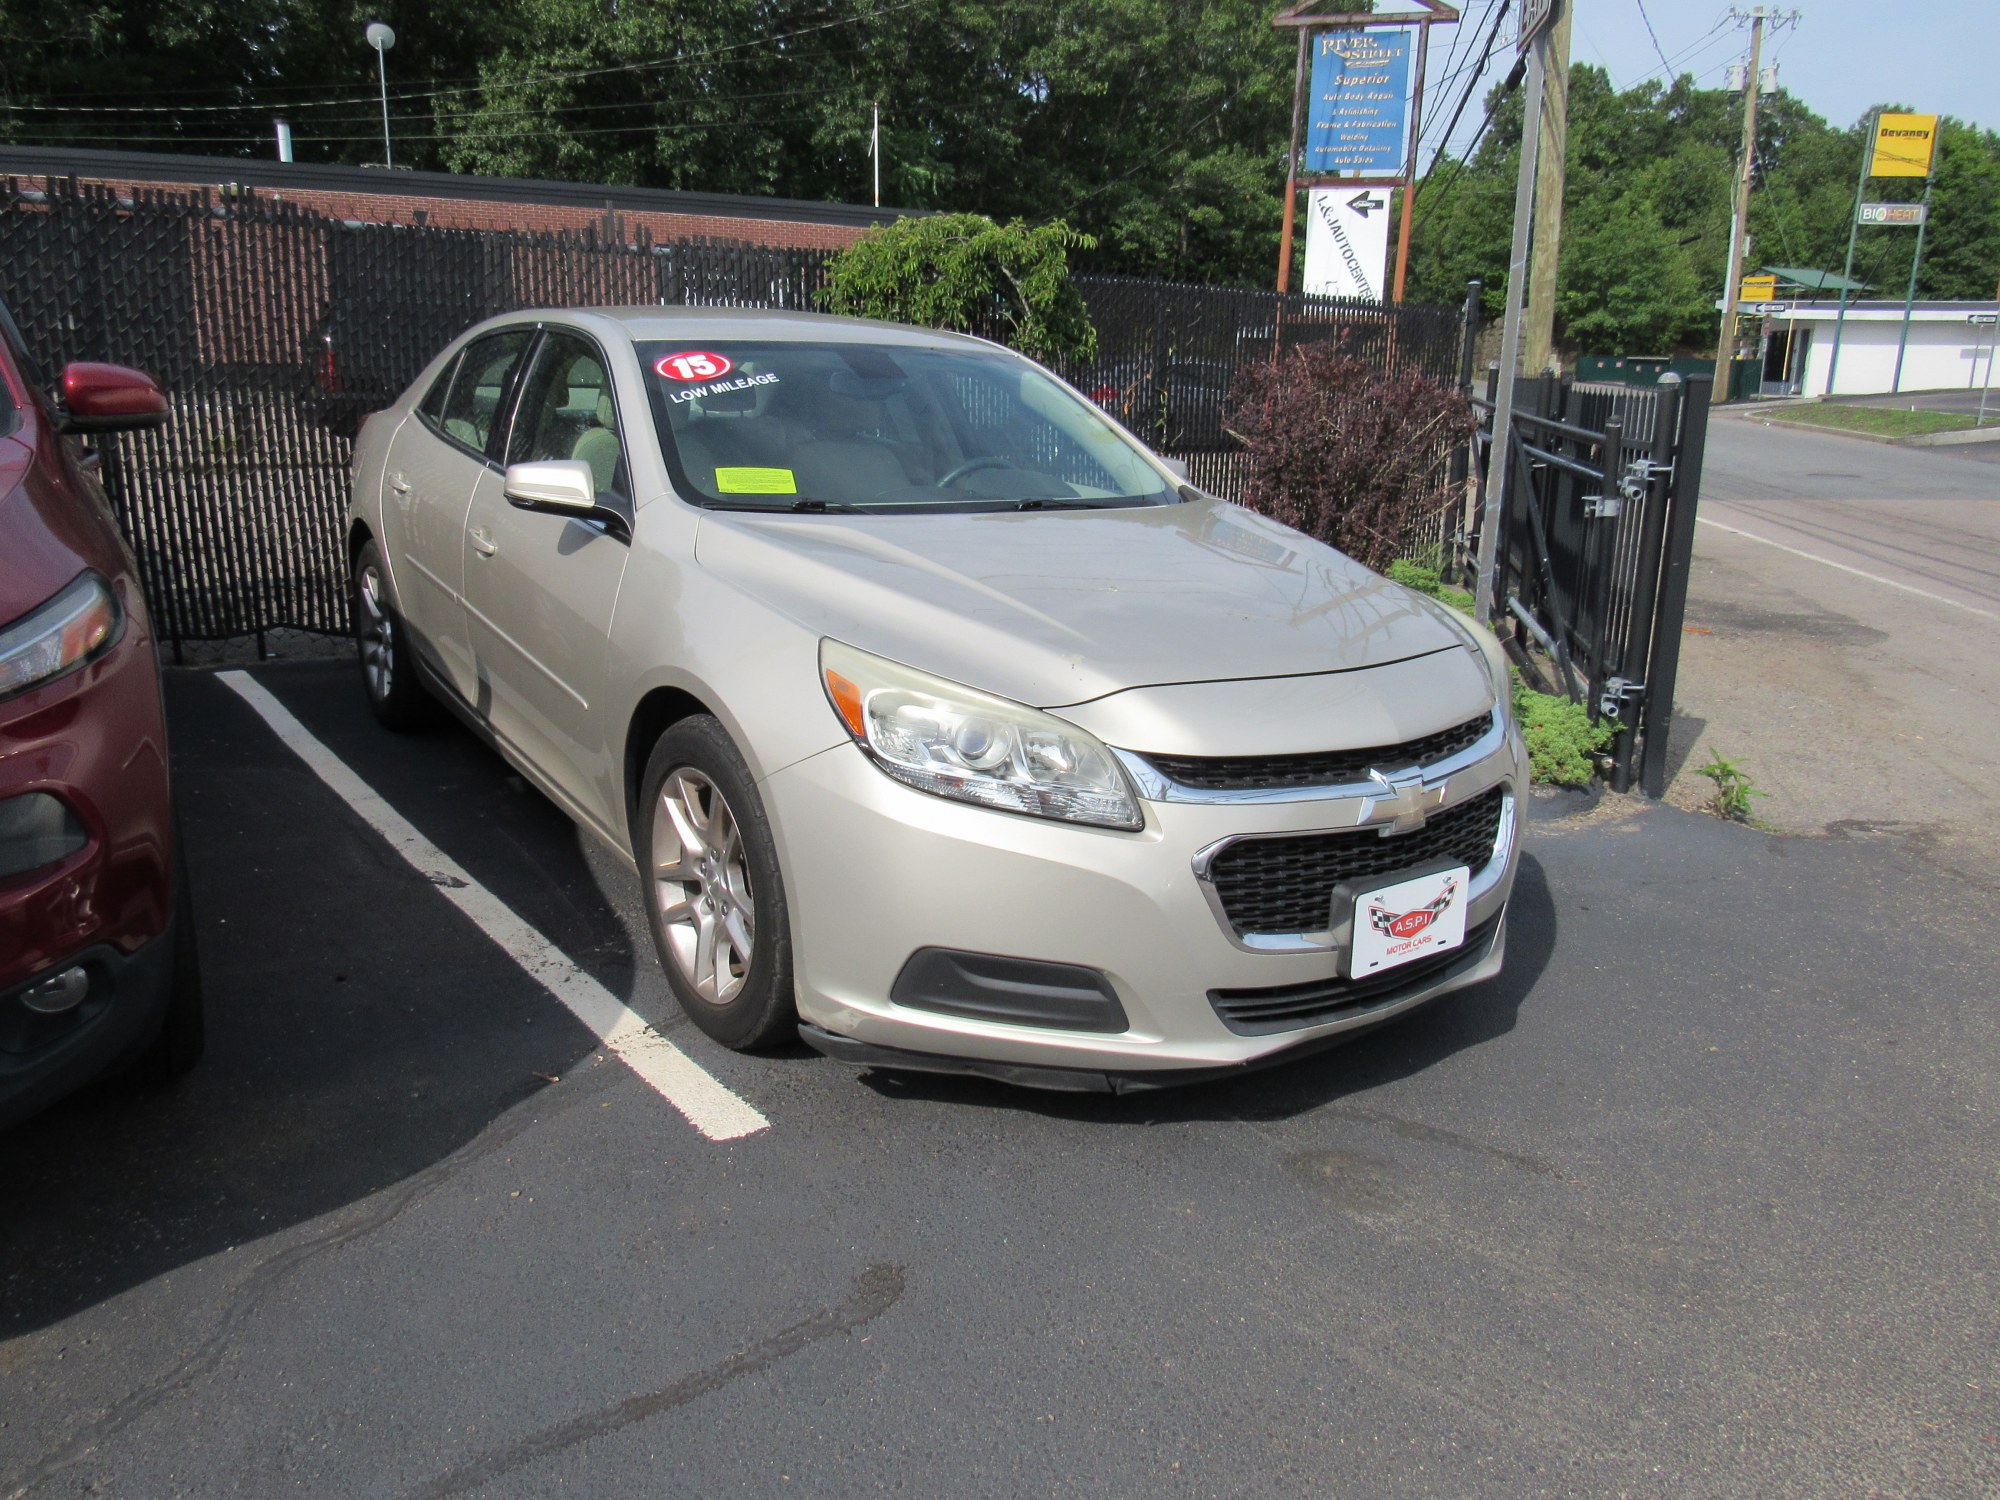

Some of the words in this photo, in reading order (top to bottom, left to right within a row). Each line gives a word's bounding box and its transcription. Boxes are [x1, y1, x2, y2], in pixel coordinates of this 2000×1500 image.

[1322, 37, 1378, 56] RIVER
[1334, 72, 1390, 86] Superior
[1323, 93, 1341, 101] Auto
[1344, 92, 1364, 101] Body
[1316, 121, 1342, 129] Frame
[1352, 119, 1397, 128] Fabrication
[1340, 133, 1368, 142] Welding
[1880, 128, 1930, 139] Devaney
[1334, 156, 1351, 164] Auto
[672, 354, 717, 378] 15
[670, 387, 708, 404] LOW
[709, 373, 780, 395] MILEAGE
[1386, 941, 1411, 955] MOTOR
[1413, 935, 1432, 947] CARS
